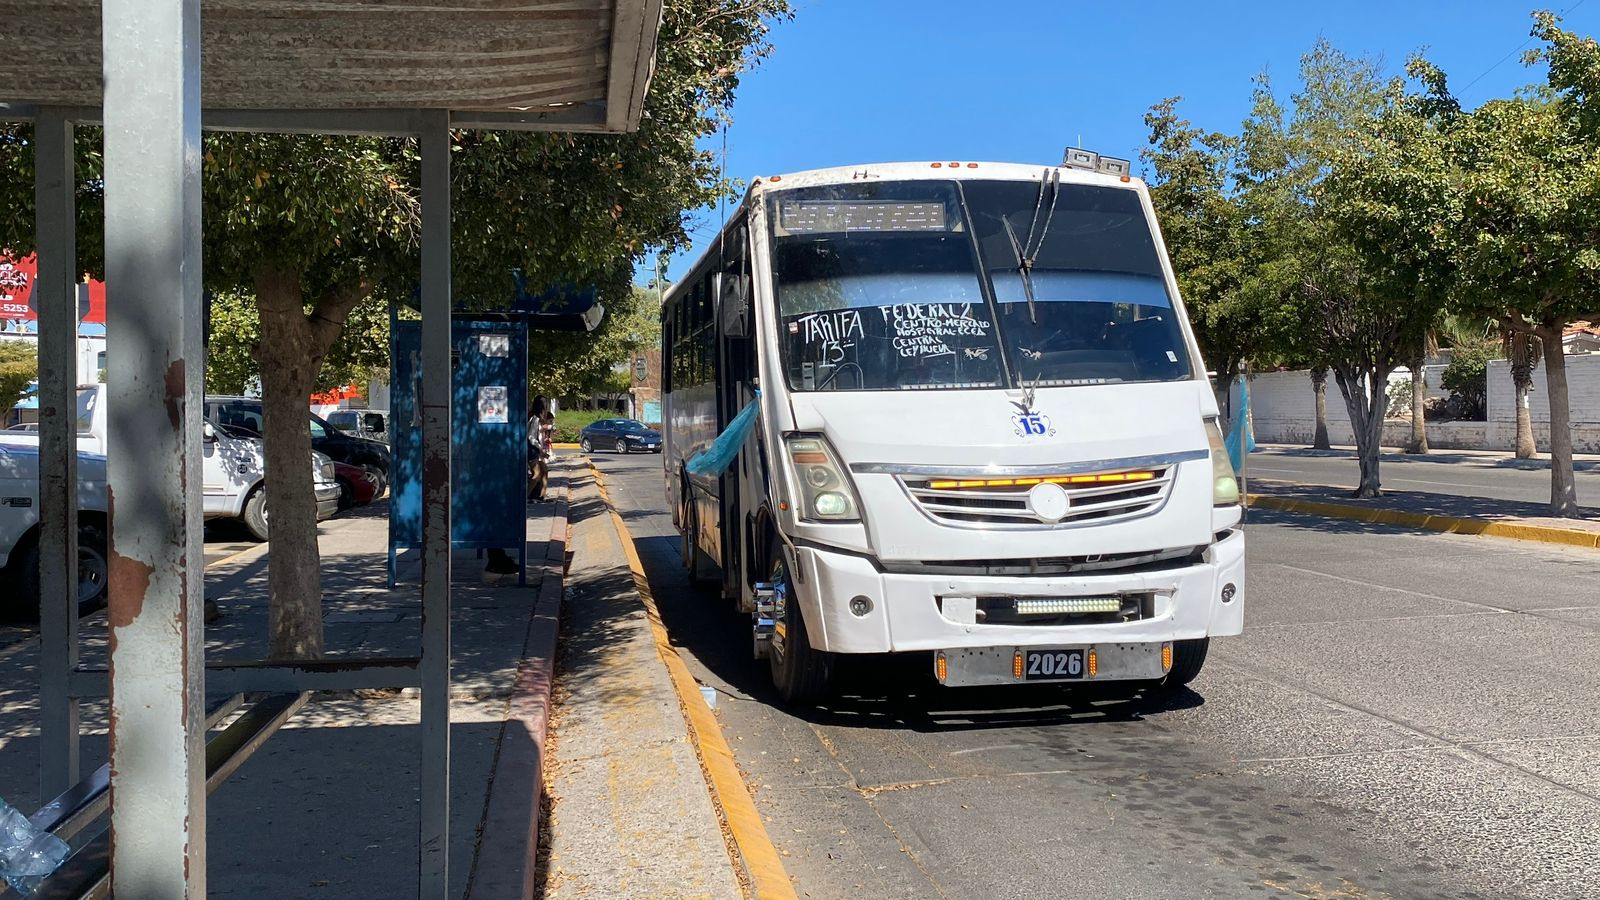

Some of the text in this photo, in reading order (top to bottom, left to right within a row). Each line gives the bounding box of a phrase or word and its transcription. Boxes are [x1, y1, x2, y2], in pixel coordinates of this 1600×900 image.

[878, 303, 960, 321] FEDERAL
[798, 310, 865, 344] TARIFA
[892, 335, 943, 349] CENTRAL
[1019, 417, 1046, 435] 15
[1028, 653, 1081, 675] 2026
